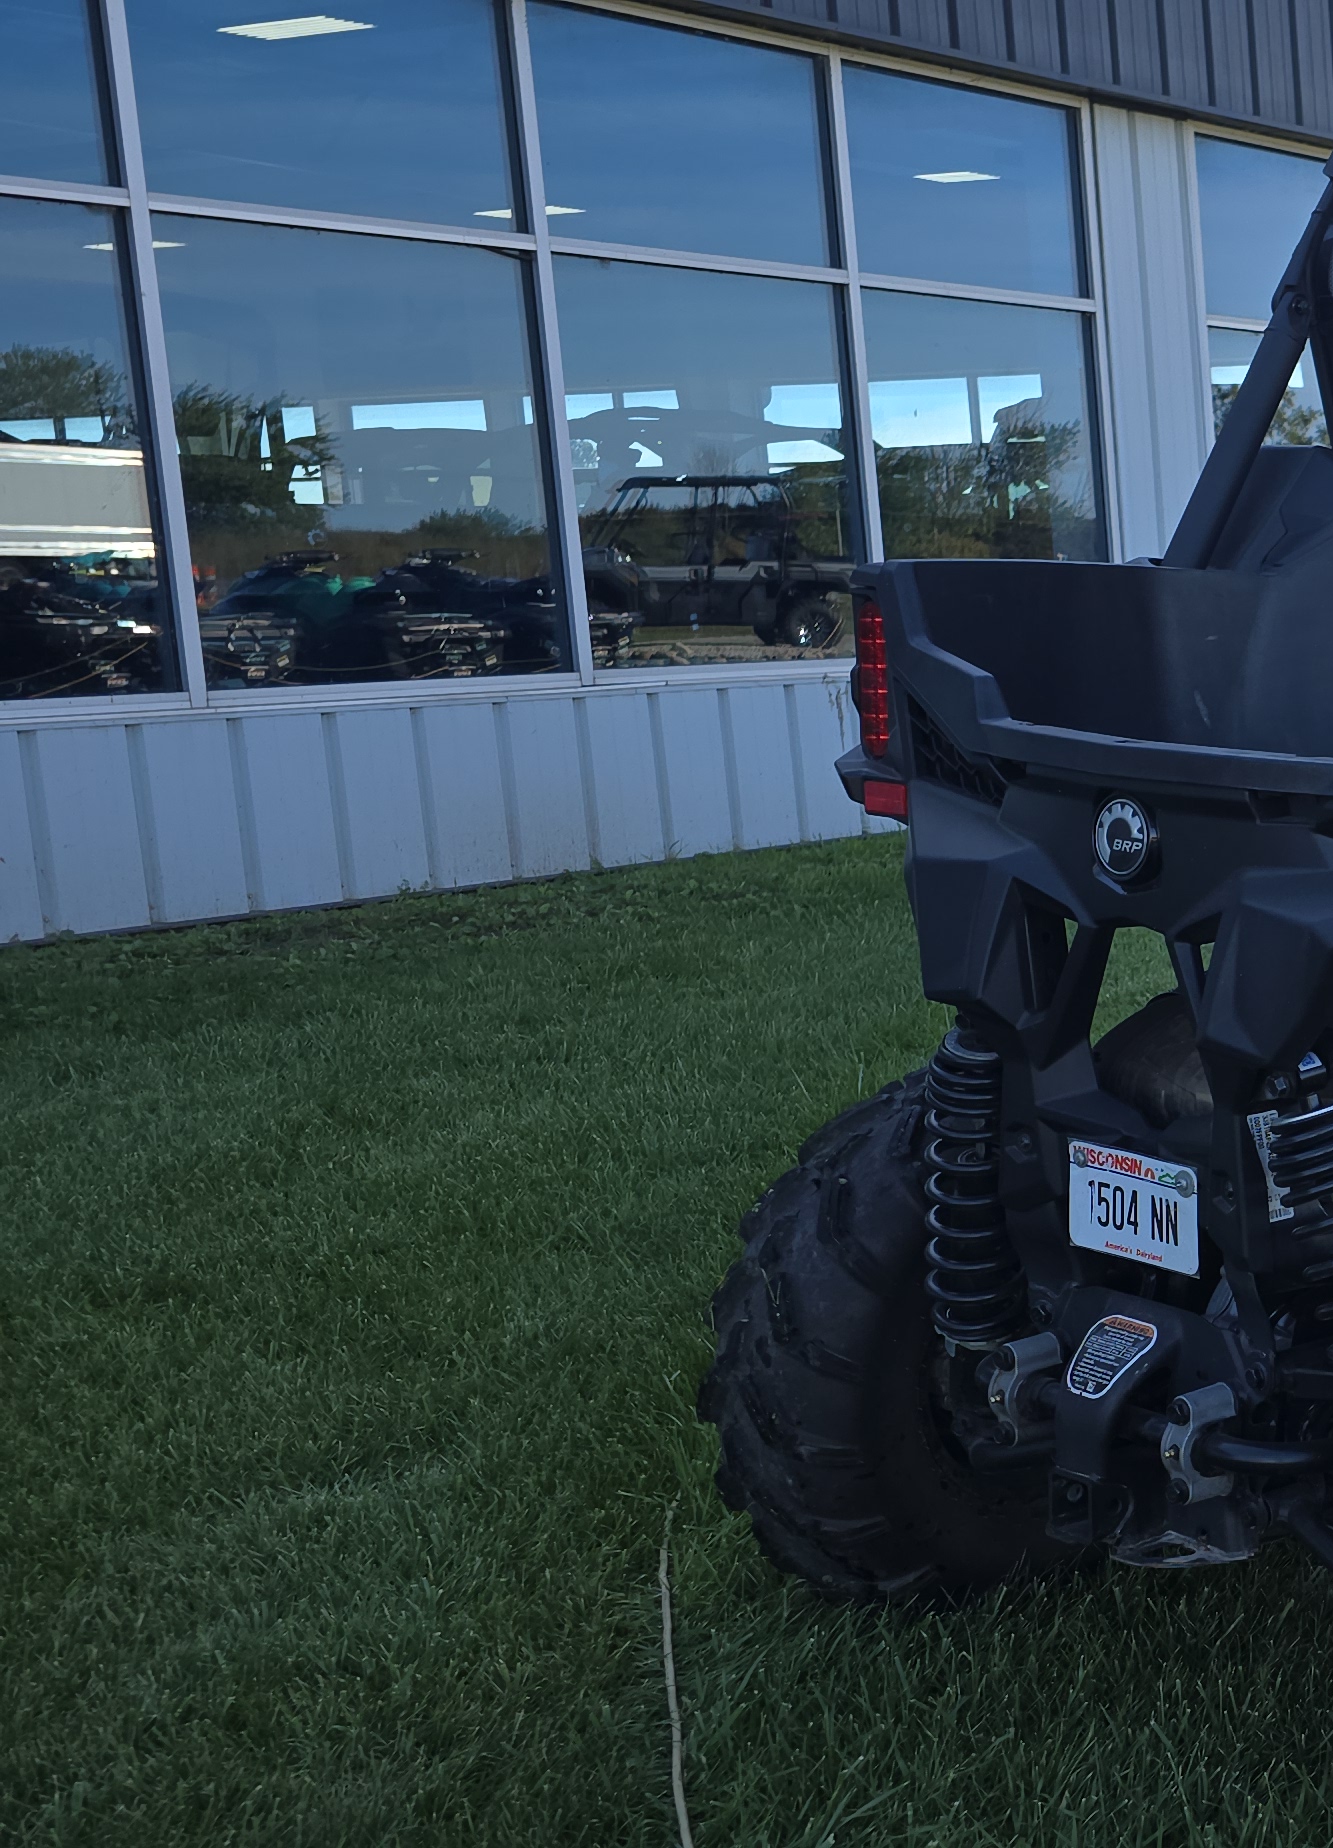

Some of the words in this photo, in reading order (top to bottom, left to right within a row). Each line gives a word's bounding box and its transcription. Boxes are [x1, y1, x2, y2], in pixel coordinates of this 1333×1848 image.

[1113, 838, 1142, 853] BRP
[1088, 1180, 1138, 1235] 1504
[1151, 1194, 1178, 1247] NN
[1105, 1240, 1132, 1254] America's
[1136, 1248, 1162, 1262] Dairyland
